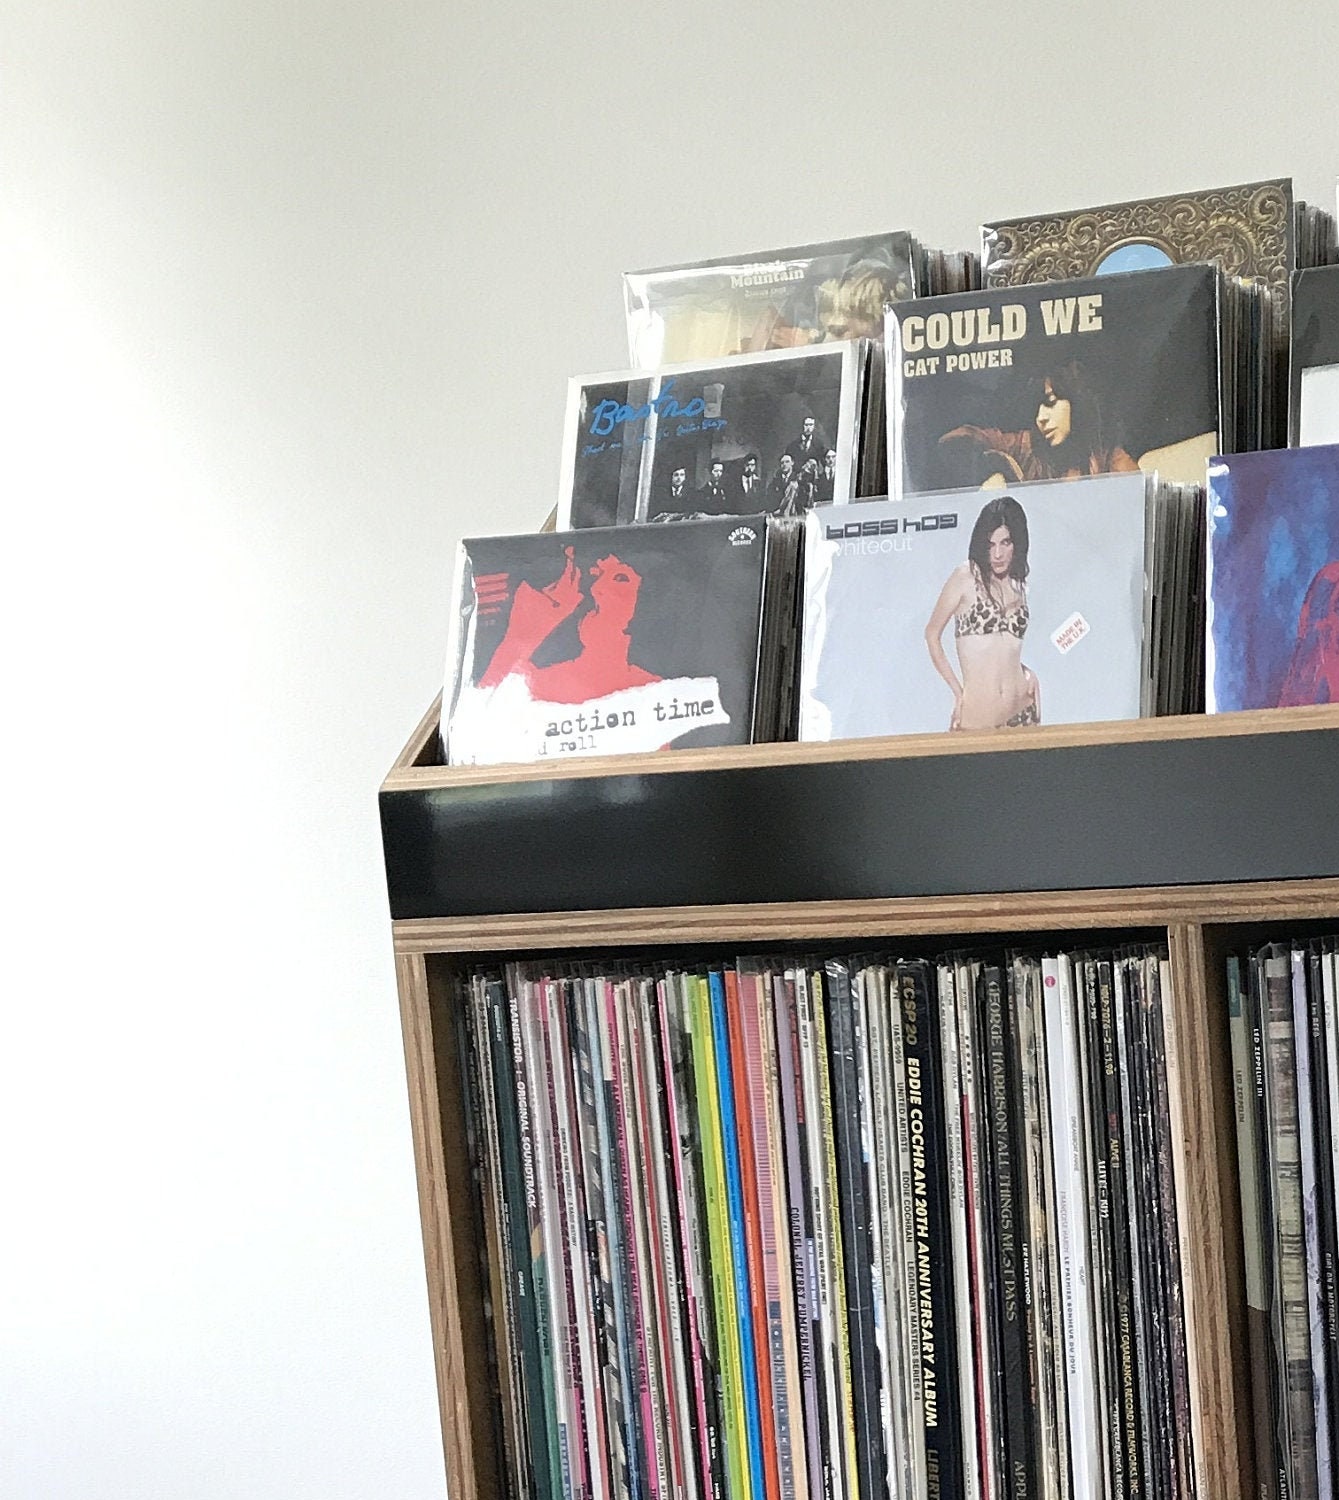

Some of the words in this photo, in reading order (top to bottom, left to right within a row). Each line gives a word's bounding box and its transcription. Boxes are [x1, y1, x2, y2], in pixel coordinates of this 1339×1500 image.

[731, 268, 804, 289] Mountain
[903, 304, 1027, 352] COULD
[1040, 295, 1102, 336] WE
[904, 357, 939, 377] CAT
[946, 349, 1013, 373] POWER
[545, 709, 635, 737] action
[653, 698, 715, 722] time
[560, 735, 597, 753] roll
[508, 998, 522, 1062] TRANSISTOR
[987, 981, 1003, 1046] GEORGE
[906, 1057, 922, 1103] EDDIE
[1253, 1046, 1262, 1083] ZEPPELIN
[515, 1081, 529, 1131] ORIGINAL
[896, 1083, 905, 1114] UNITED
[898, 1117, 908, 1152] ARTISTS
[908, 1108, 927, 1196] COCHRAN
[520, 1136, 536, 1207] SOUNDTRACK
[901, 1171, 910, 1196] EDDIE
[902, 1199, 913, 1242] COCHRAN
[913, 1198, 929, 1237] 20TH
[998, 1173, 1013, 1229] THINGS
[790, 1207, 802, 1250] COLONEL
[793, 1254, 805, 1297] JEFFREY
[1000, 1233, 1015, 1276] MUST
[905, 1261, 917, 1312] LEGENDARY
[913, 1241, 937, 1364] ANNIVERSARY
[1004, 1280, 1017, 1321] PASS
[1063, 1267, 1072, 1300] PREMIER
[796, 1303, 811, 1380] PUMPERNICKEL
[907, 1315, 919, 1355] MASTERS
[1066, 1302, 1074, 1339] BONHEUR
[910, 1358, 920, 1388] SERIES
[921, 1367, 938, 1426] ALBUM
